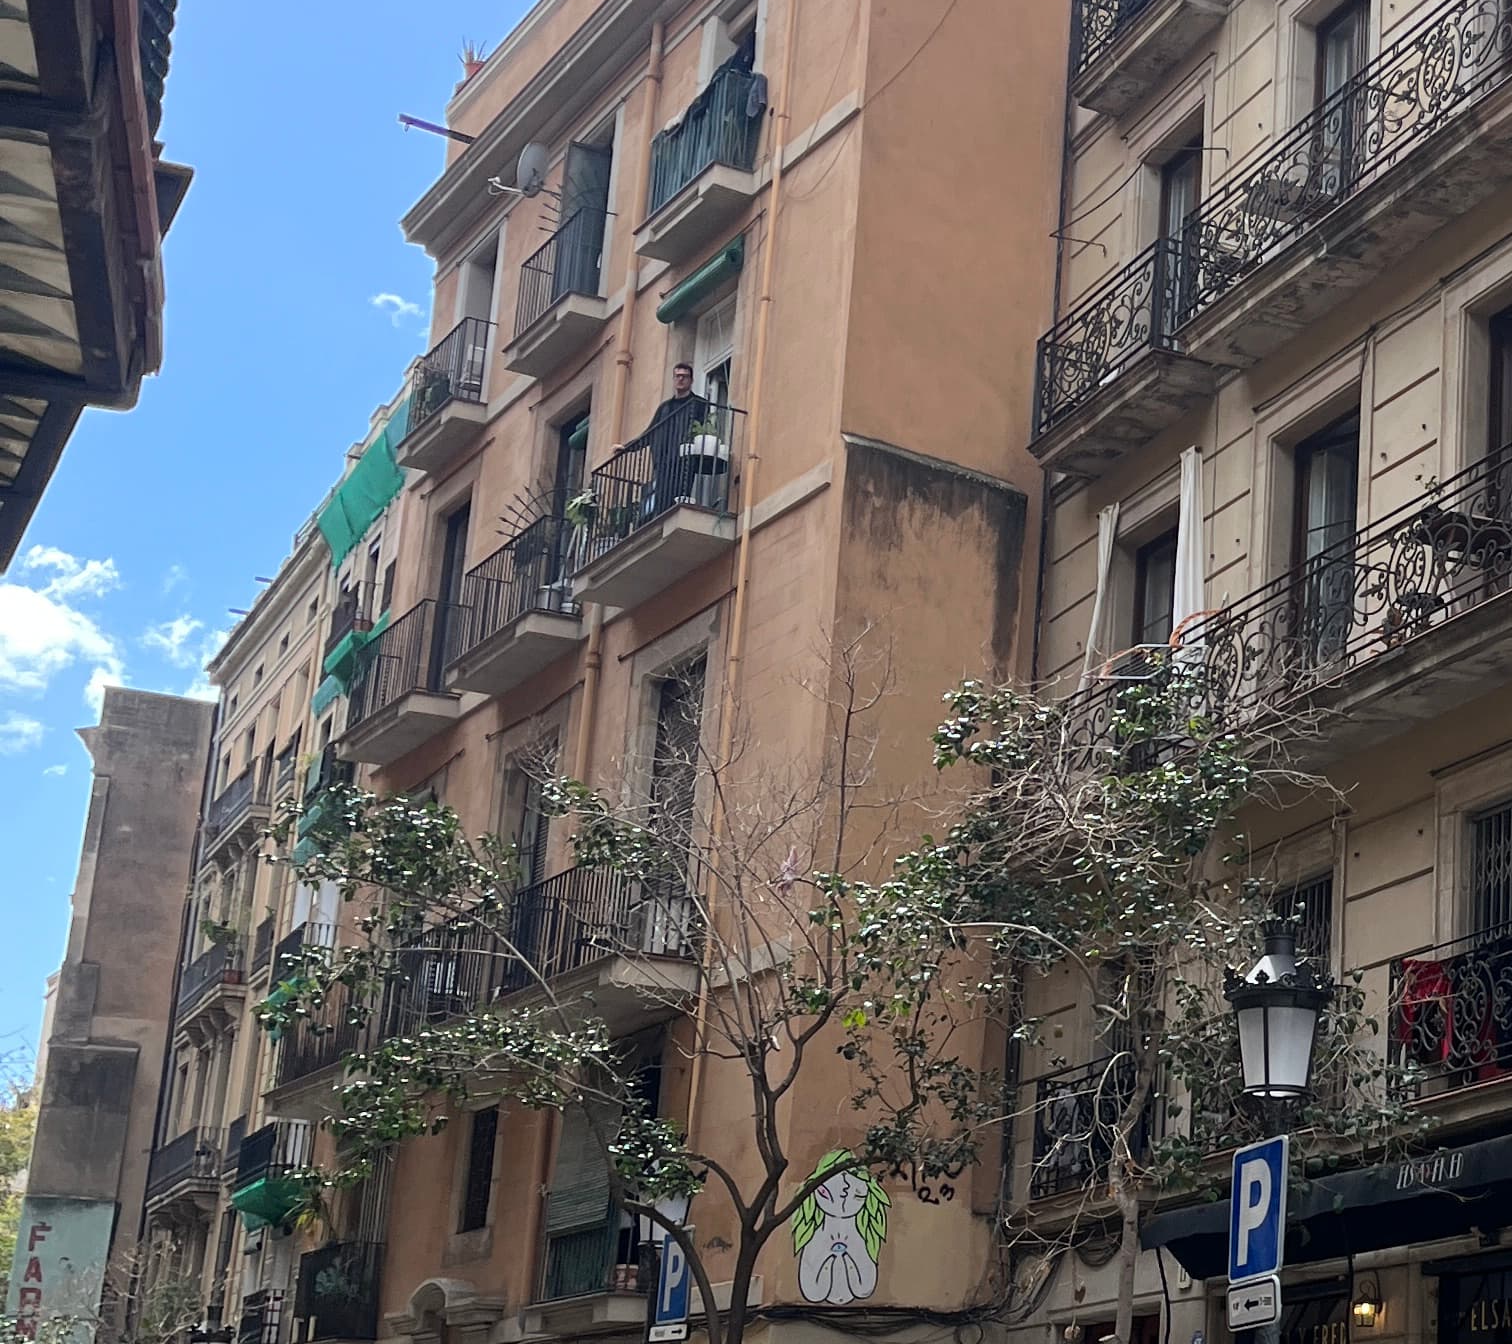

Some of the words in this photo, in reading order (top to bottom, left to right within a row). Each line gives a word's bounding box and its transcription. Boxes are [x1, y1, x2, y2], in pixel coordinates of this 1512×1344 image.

[1236, 1158, 1272, 1267] P
[663, 1241, 685, 1313] P
[1471, 1297, 1511, 1331] ELSA
